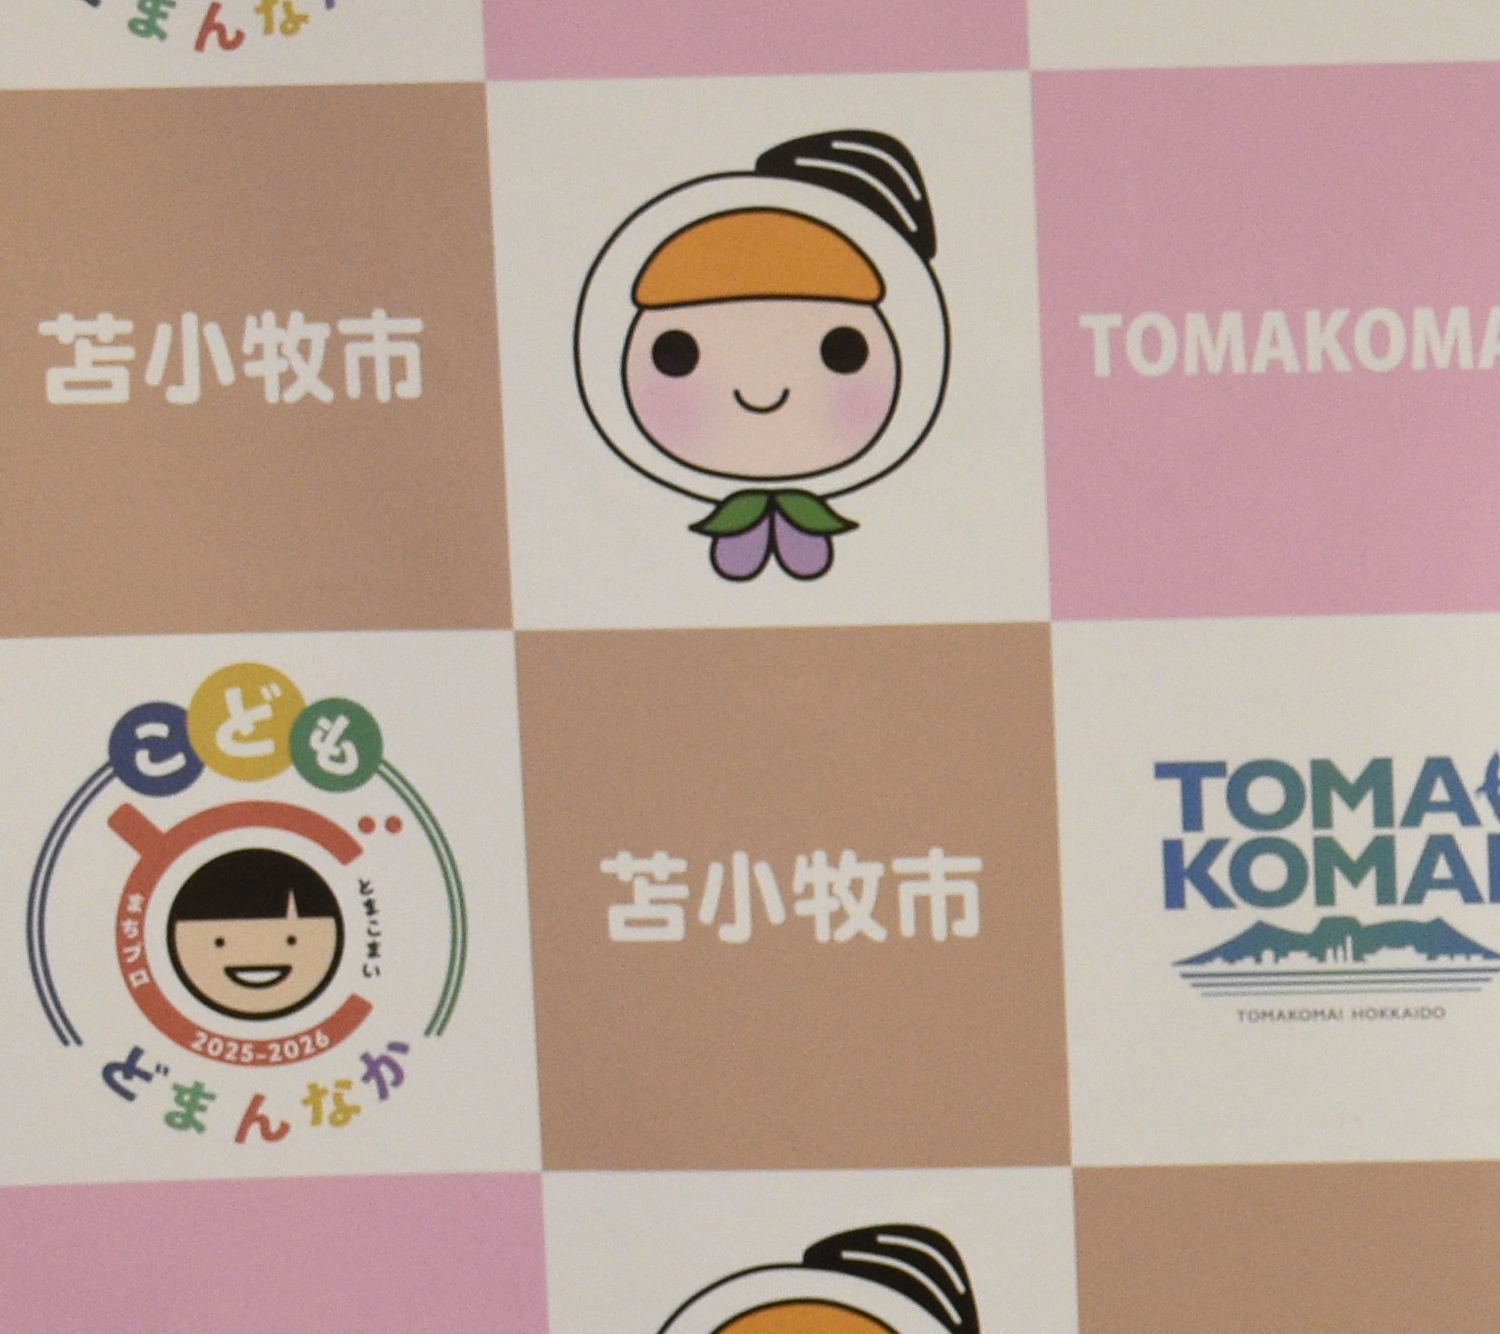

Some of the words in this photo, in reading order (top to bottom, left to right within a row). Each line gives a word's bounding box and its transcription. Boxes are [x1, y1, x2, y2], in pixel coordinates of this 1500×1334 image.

[38, 308, 424, 405] 苫小牧市
[133, 682, 363, 775] こども
[1153, 754, 1482, 835] TOMA
[600, 847, 983, 943] 苫小牧市
[188, 1028, 331, 1064] 2025-2026
[1236, 1007, 1344, 1025] TOMAKOMAI
[1351, 1006, 1446, 1022] HOKKAIDO
[102, 1042, 412, 1144] どまんなか
